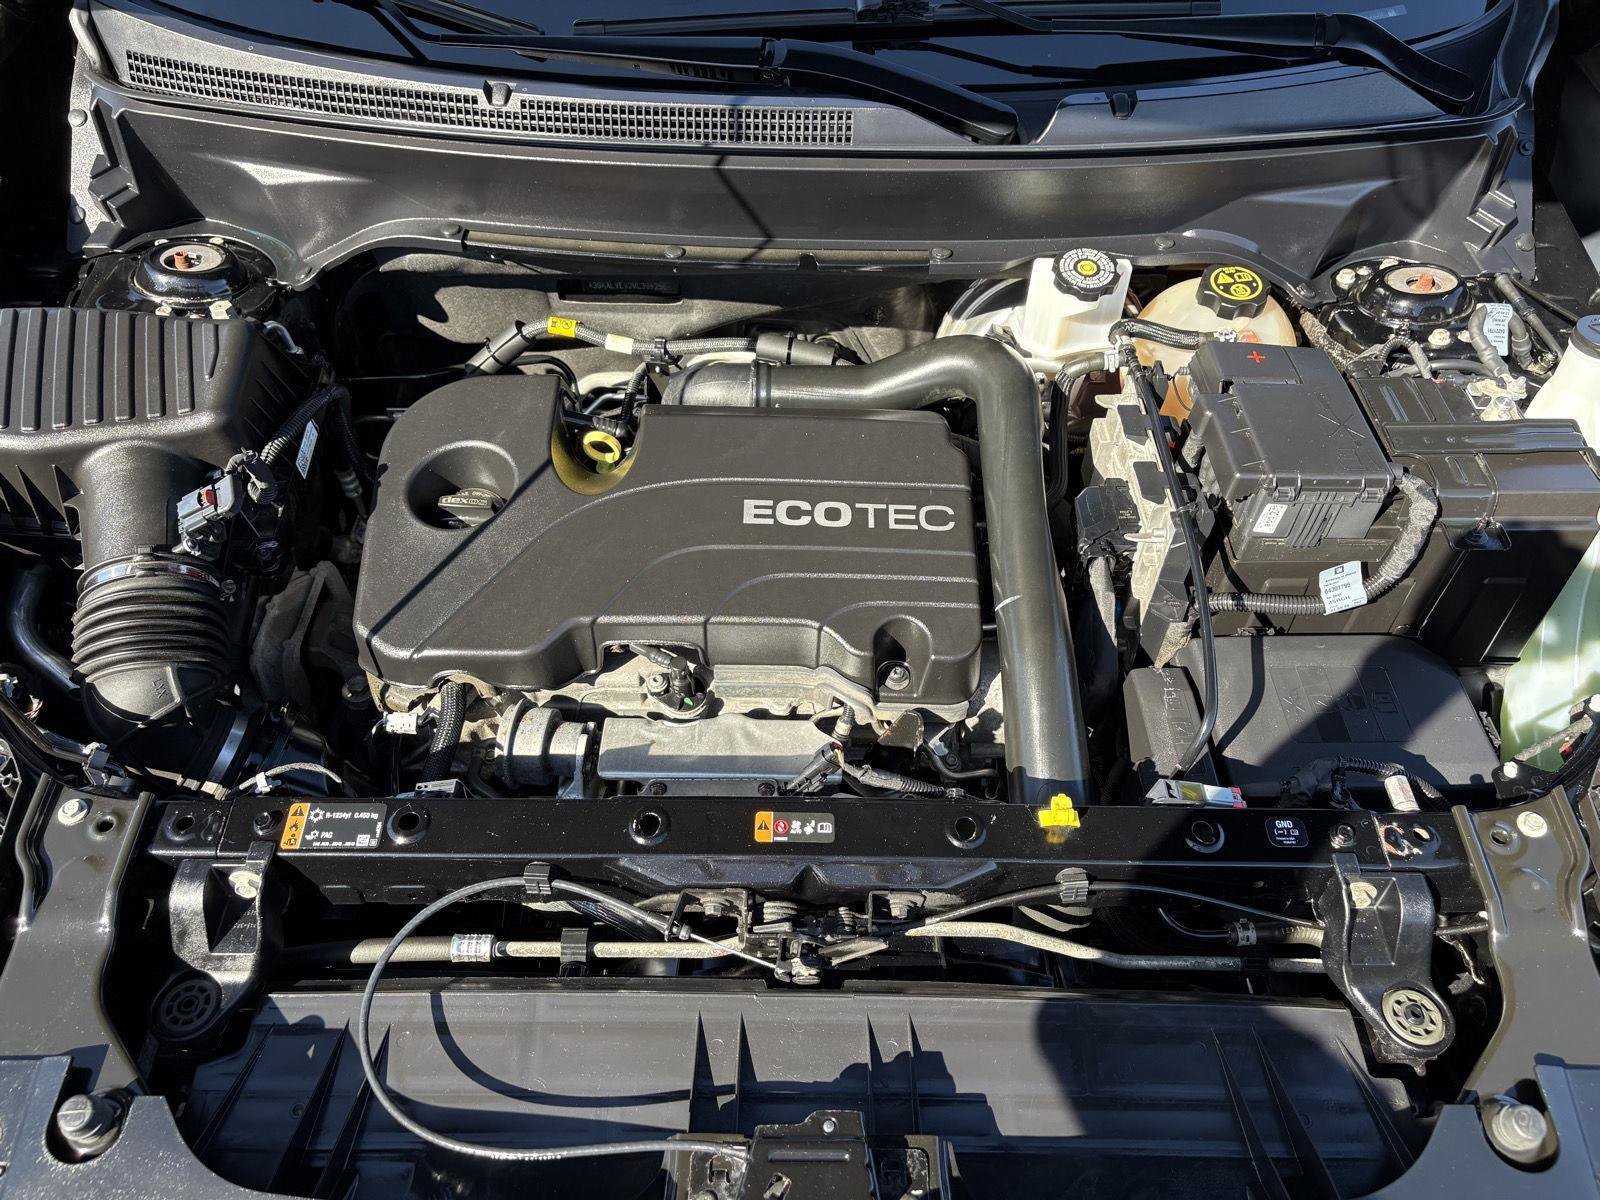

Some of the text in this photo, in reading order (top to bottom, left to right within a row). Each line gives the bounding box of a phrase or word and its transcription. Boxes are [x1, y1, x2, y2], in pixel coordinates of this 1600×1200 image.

[743, 499, 956, 532] ECOTEC
[371, 812, 379, 820] kg
[1275, 820, 1293, 828] GND
